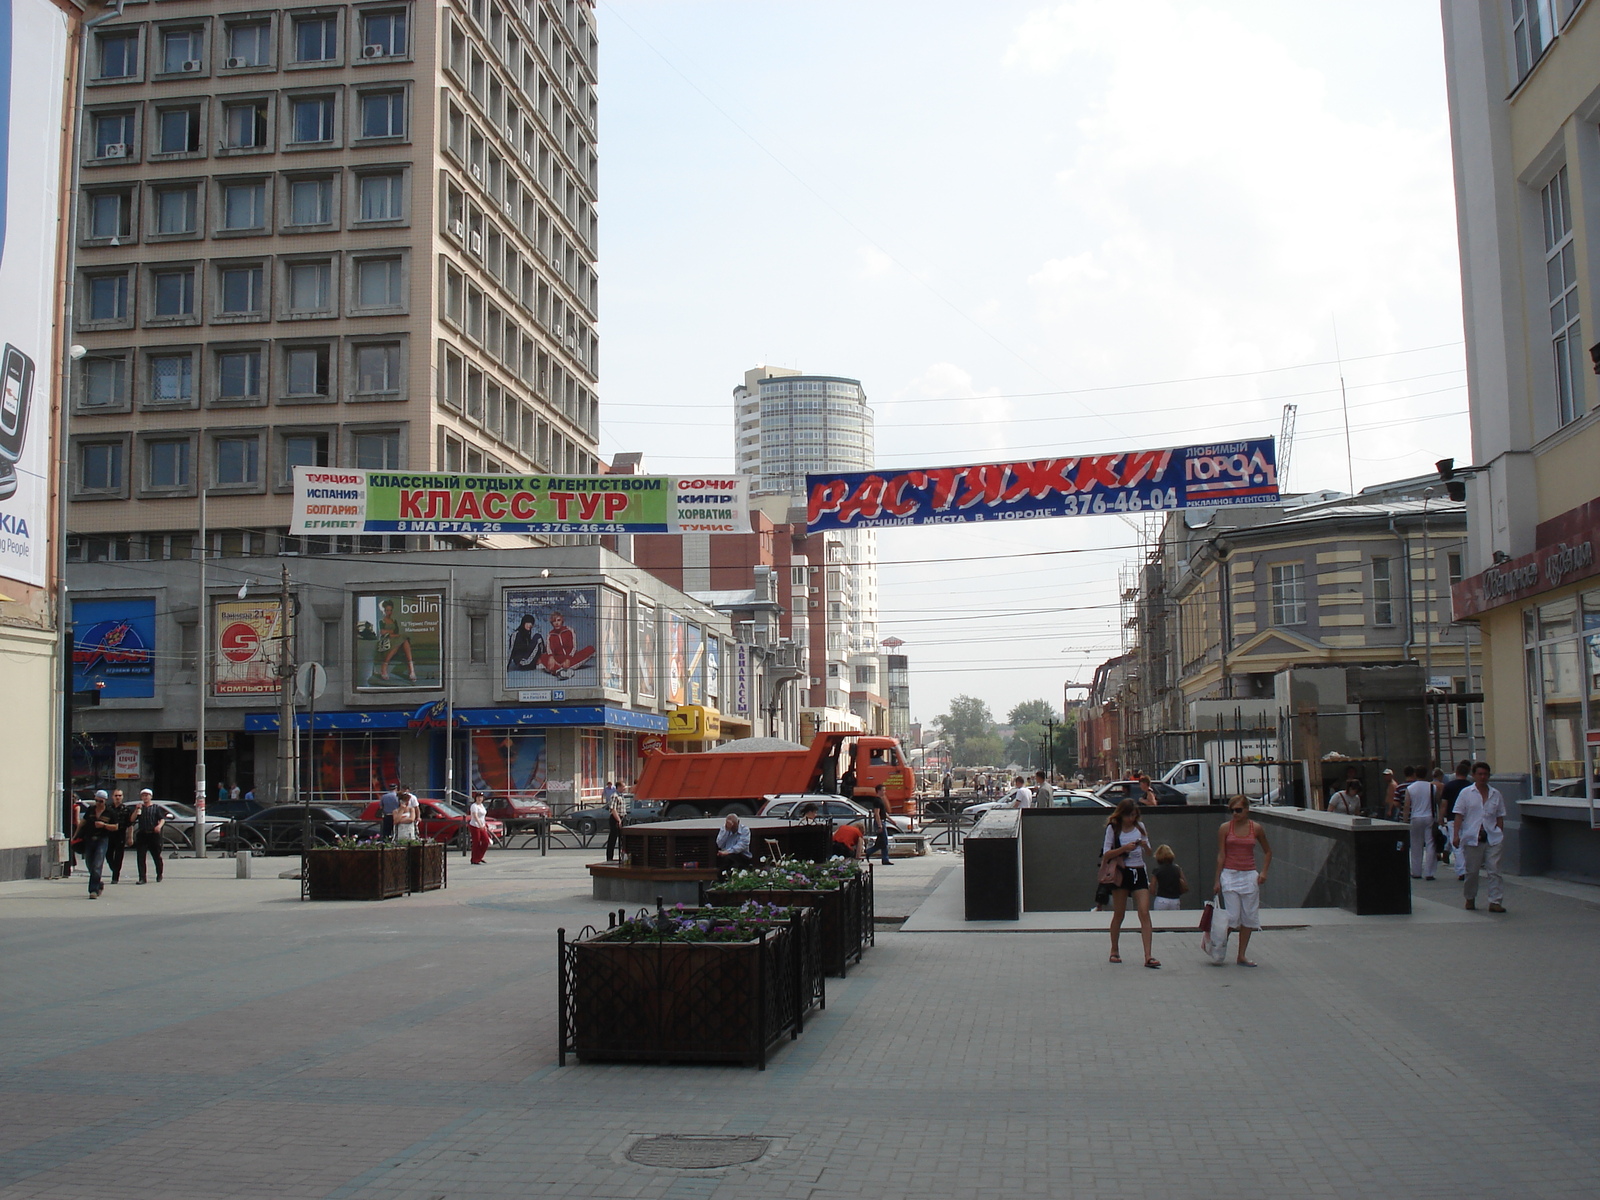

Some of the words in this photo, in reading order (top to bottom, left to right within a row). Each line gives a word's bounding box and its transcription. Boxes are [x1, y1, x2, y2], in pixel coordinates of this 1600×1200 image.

[1186, 442, 1248, 457] ЛЮБИМЫЙ
[1185, 447, 1278, 486] ГОРОД
[306, 473, 358, 484] ТУРЦИЯ
[369, 475, 460, 490] КЛАССНЫЙ
[465, 478, 525, 492] ОТДЫХ
[530, 478, 541, 490] С
[547, 478, 661, 491] АГЕНТСТВОМ
[678, 479, 734, 490] СОЧИ
[807, 449, 1175, 526] РАСТЯЖКИ
[307, 489, 358, 500] ИСПАНИЯ
[677, 494, 732, 504] КИПР
[399, 489, 537, 521] КЛАСС
[549, 491, 630, 521] ТУР
[1064, 487, 1178, 516] 376-46-04
[1186, 498, 1234, 508] РЕКЛАМНОЕ
[1235, 495, 1278, 505] АГЕНТСТВО
[306, 504, 358, 516] БОЛГАРИЯ
[678, 509, 732, 520] ХОРВАТИЯ
[304, 520, 358, 529] ЕГИПЕТ
[857, 518, 915, 528] ЛУЧШИЕ
[923, 515, 966, 525] МЕСТА
[975, 513, 984, 522] В
[993, 508, 1057, 521] "ГОРОДЕ"
[397, 521, 406, 531] 8
[411, 521, 478, 533] МАРТА,
[483, 522, 502, 532] 26
[679, 524, 735, 532] ТУНИС
[7, 538, 30, 557] People
[1483, 562, 1538, 600] Ювелирные
[1545, 541, 1593, 586] изделия
[254, 610, 264, 618] 21
[738, 645, 747, 711] АВИАКАССЫ
